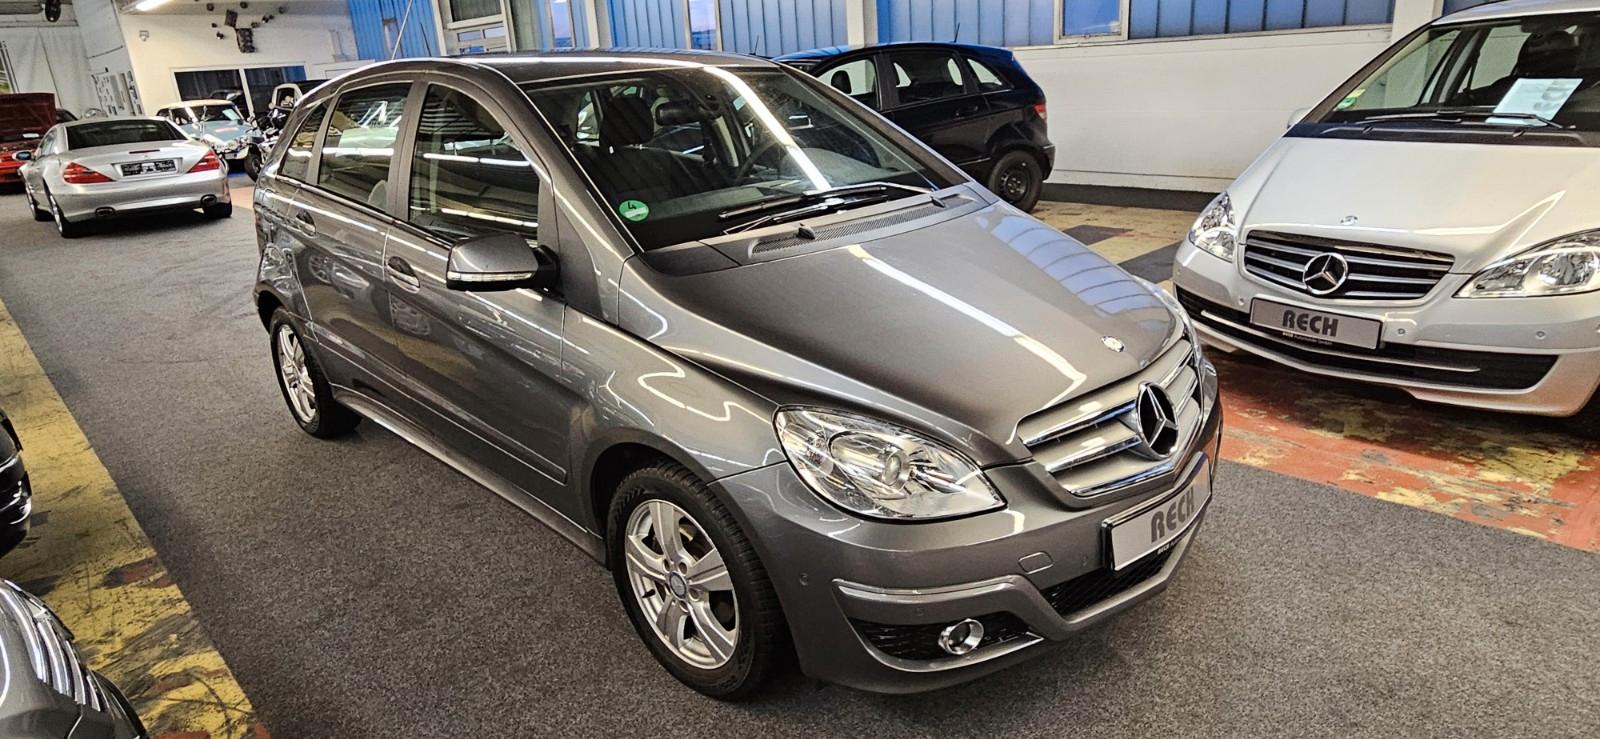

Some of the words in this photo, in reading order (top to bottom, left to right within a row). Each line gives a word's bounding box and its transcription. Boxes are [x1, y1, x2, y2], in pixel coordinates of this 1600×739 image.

[627, 201, 637, 210] 4
[1282, 310, 1338, 337] RECH
[1151, 485, 1194, 544] RECH
